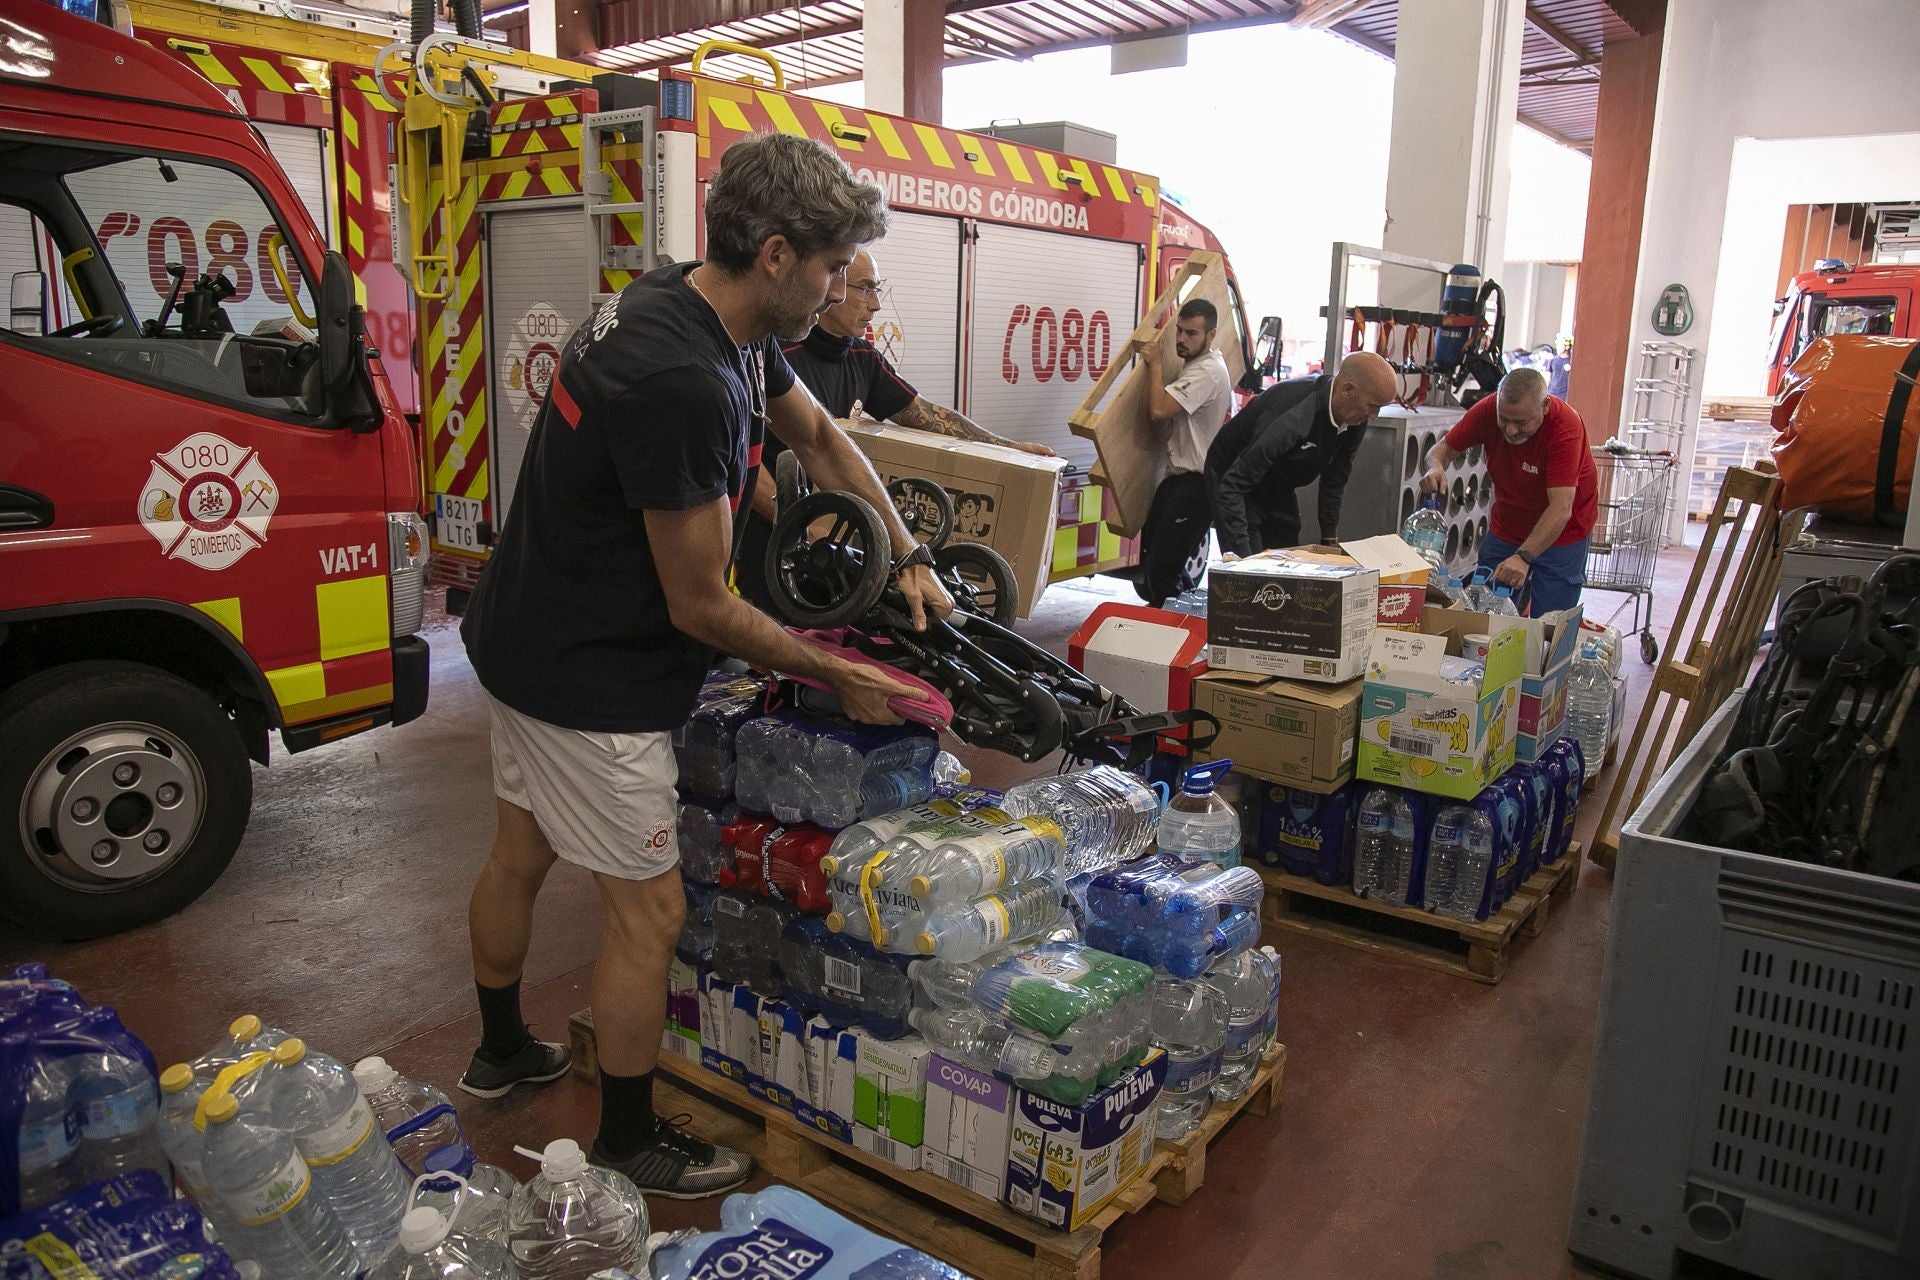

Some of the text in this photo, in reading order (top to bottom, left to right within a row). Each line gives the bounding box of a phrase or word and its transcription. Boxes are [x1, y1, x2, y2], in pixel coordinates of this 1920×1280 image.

[856, 168, 1090, 231] OMBEROS CÓRDOBA
[147, 216, 301, 305] 080
[527, 313, 558, 338] 080
[1031, 306, 1111, 382] 080
[181, 444, 229, 469] 080
[445, 499, 479, 522] 8217
[190, 533, 242, 557] BOMBEROS
[447, 523, 472, 545] LTG
[319, 543, 378, 575] VAT-1
[873, 884, 921, 913] iviana
[863, 1051, 907, 1077] SEMIDESNATADA
[940, 1065, 992, 1096] COVAP
[1104, 1069, 1155, 1121] PULEVA
[1027, 1093, 1073, 1120] PULEVA
[742, 1248, 824, 1280] lla
